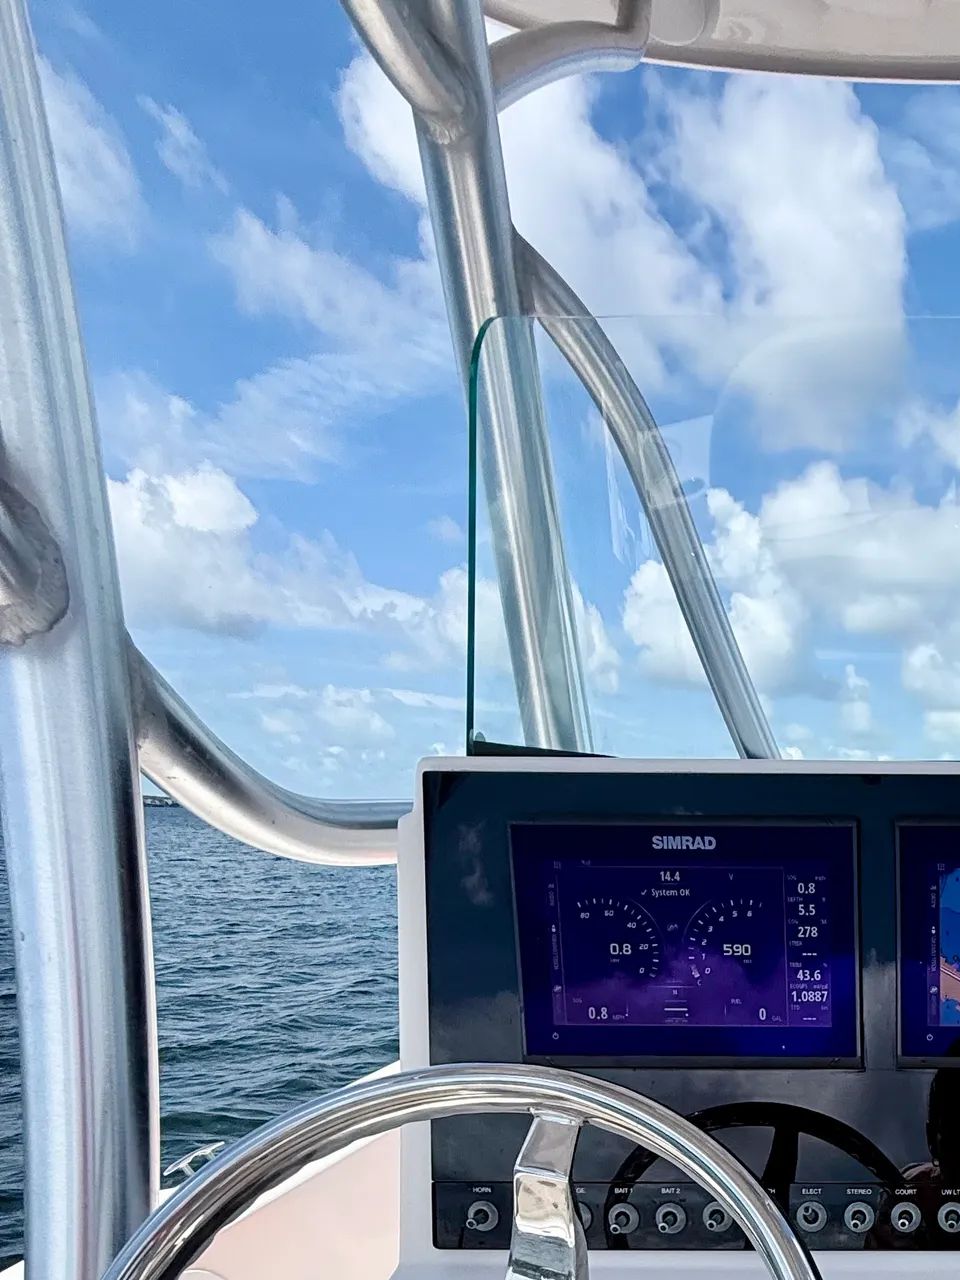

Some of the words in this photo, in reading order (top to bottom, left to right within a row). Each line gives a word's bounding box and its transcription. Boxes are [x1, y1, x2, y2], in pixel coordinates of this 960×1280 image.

[652, 836, 716, 850] SIMRAD
[660, 871, 680, 881] 14.4
[651, 888, 678, 898] System
[798, 882, 815, 894] 0.8
[798, 904, 816, 916] 5.5
[798, 926, 818, 938] 278
[610, 943, 632, 955] 0.8
[723, 944, 751, 956] 590
[797, 970, 821, 981] 43.6
[792, 990, 828, 1002] 1.0887
[588, 1007, 608, 1019] 0.8
[759, 1008, 767, 1020] 0
